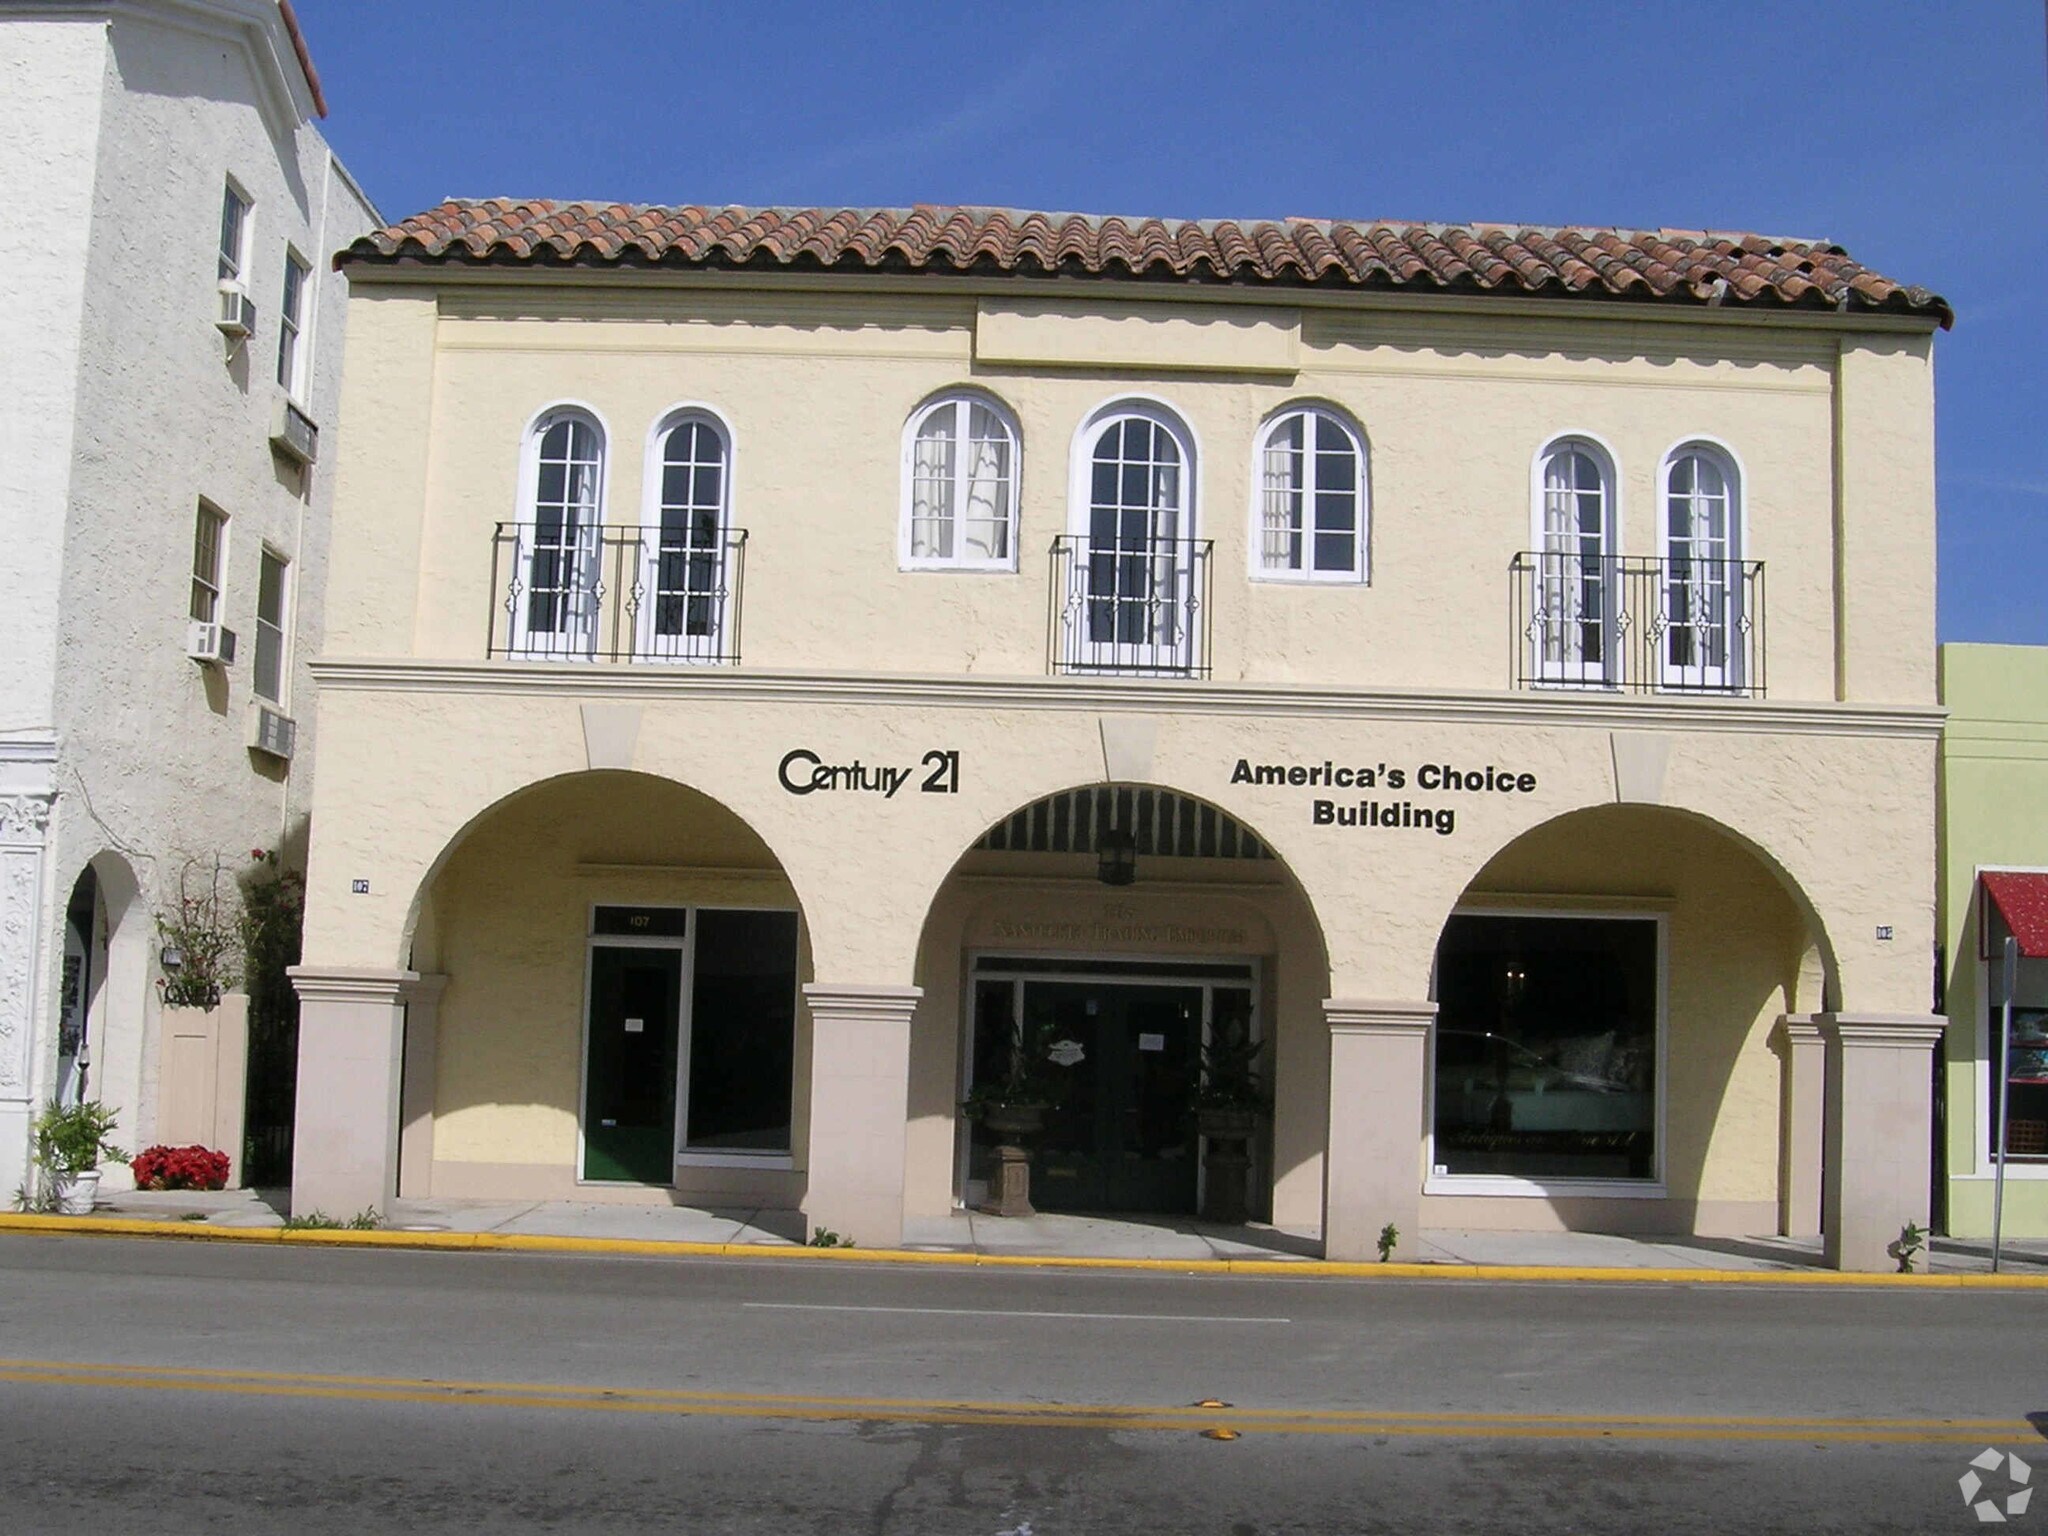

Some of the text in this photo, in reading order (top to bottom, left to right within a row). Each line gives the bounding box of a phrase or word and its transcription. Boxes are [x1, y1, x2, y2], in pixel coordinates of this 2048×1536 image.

[778, 749, 959, 798] Century 21
[1230, 759, 1536, 793] America's Choice
[1312, 800, 1455, 835] Building
[353, 881, 369, 892] 107
[630, 915, 650, 928] 107
